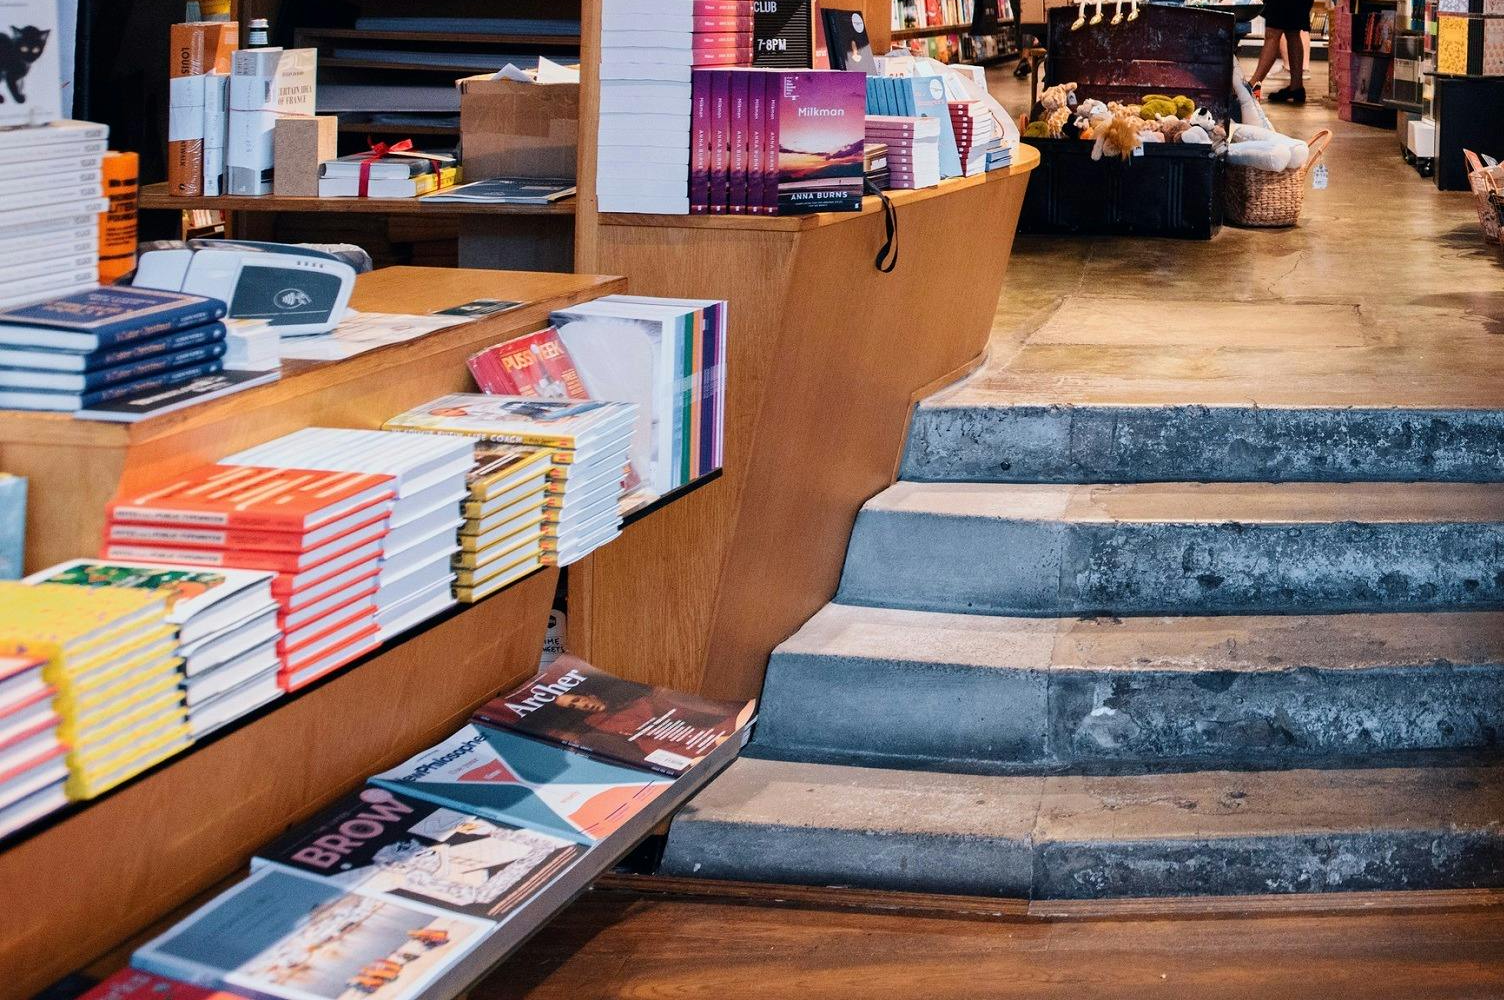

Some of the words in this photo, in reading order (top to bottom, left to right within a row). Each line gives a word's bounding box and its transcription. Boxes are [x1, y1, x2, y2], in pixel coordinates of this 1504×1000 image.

[753, 1, 777, 13] CLUB
[757, 39, 787, 51] 7-8PM
[181, 47, 190, 74] LOUIS
[798, 107, 845, 117] Milkman
[791, 193, 814, 201] ANNA
[817, 190, 848, 199] BURNS
[491, 434, 523, 444] COACH
[504, 669, 588, 718] Archer
